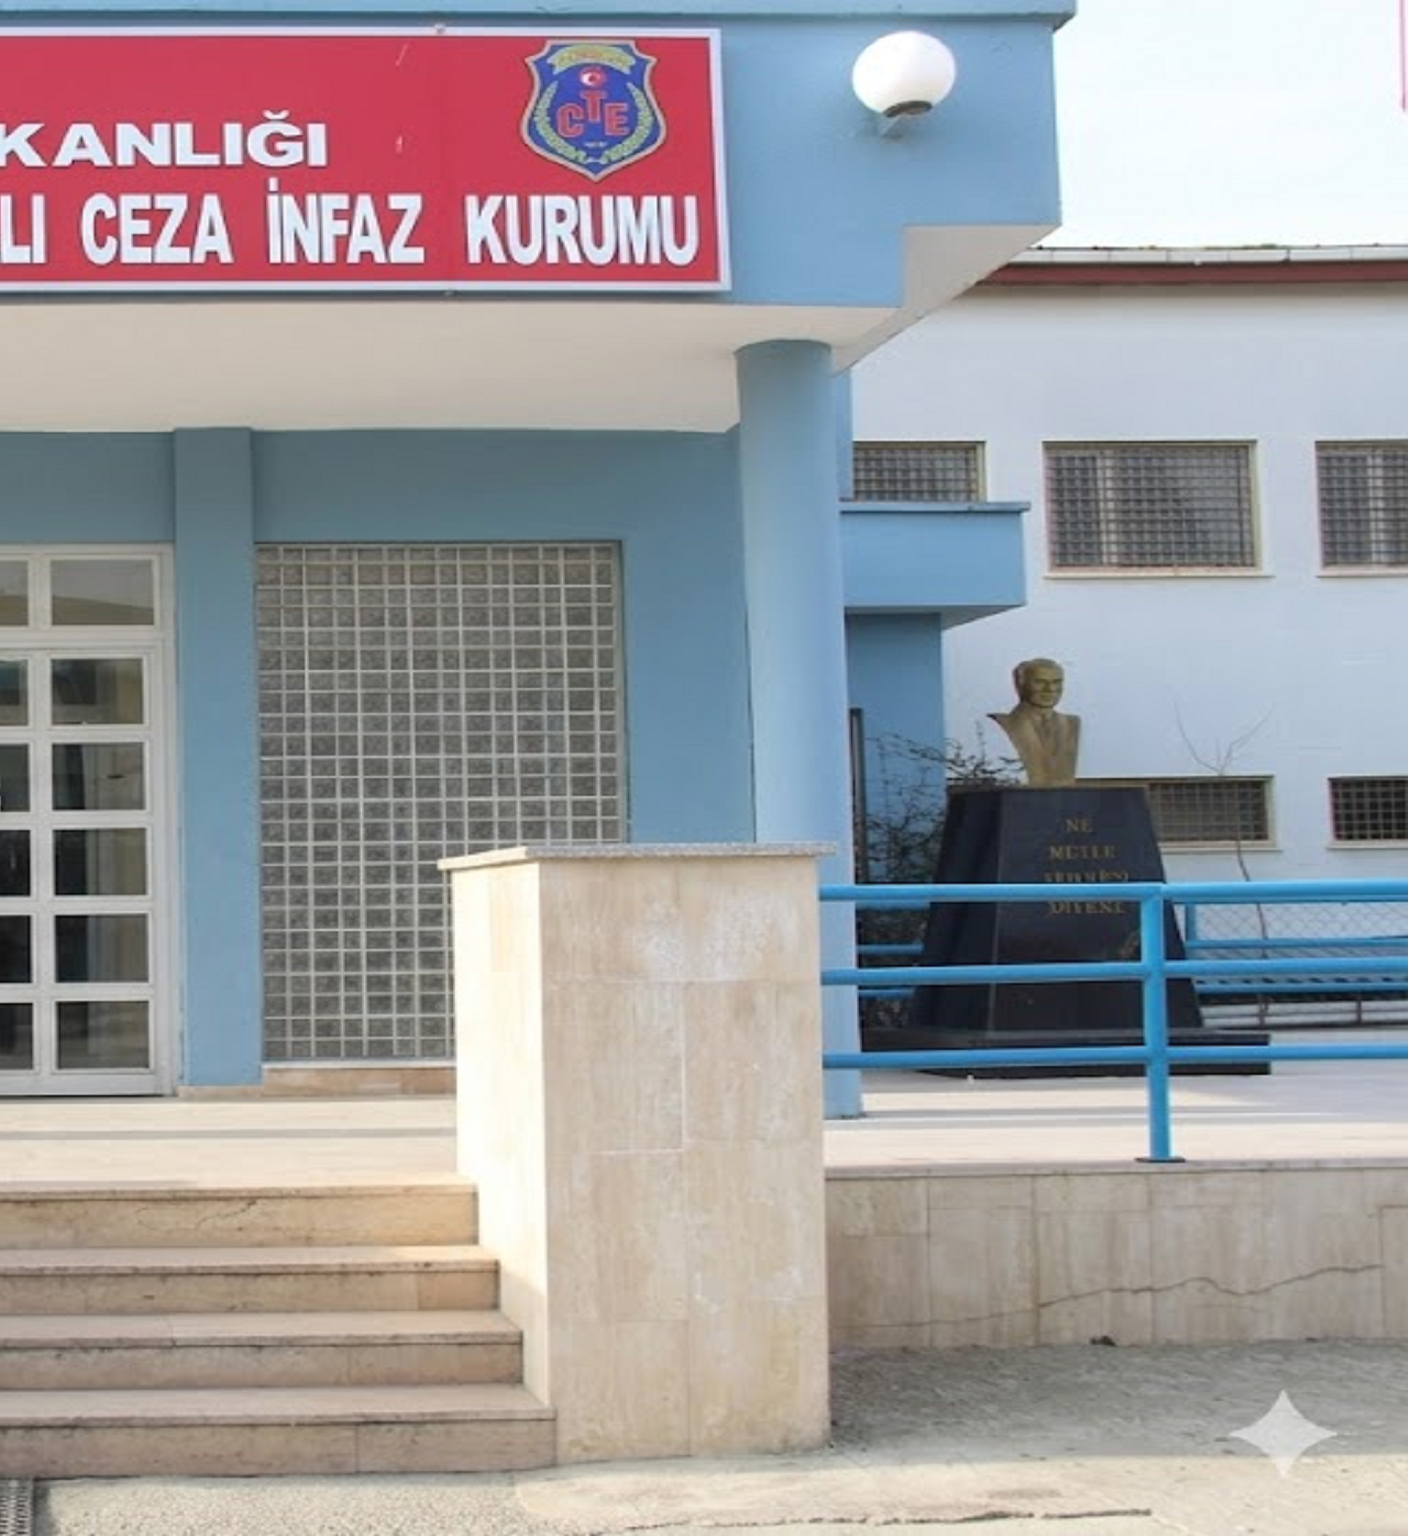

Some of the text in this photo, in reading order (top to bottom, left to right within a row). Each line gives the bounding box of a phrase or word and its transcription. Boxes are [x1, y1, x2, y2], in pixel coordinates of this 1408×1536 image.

[79, 193, 234, 264] CEZA
[266, 178, 426, 264] İNFAZ
[464, 195, 699, 265] KURUMU
